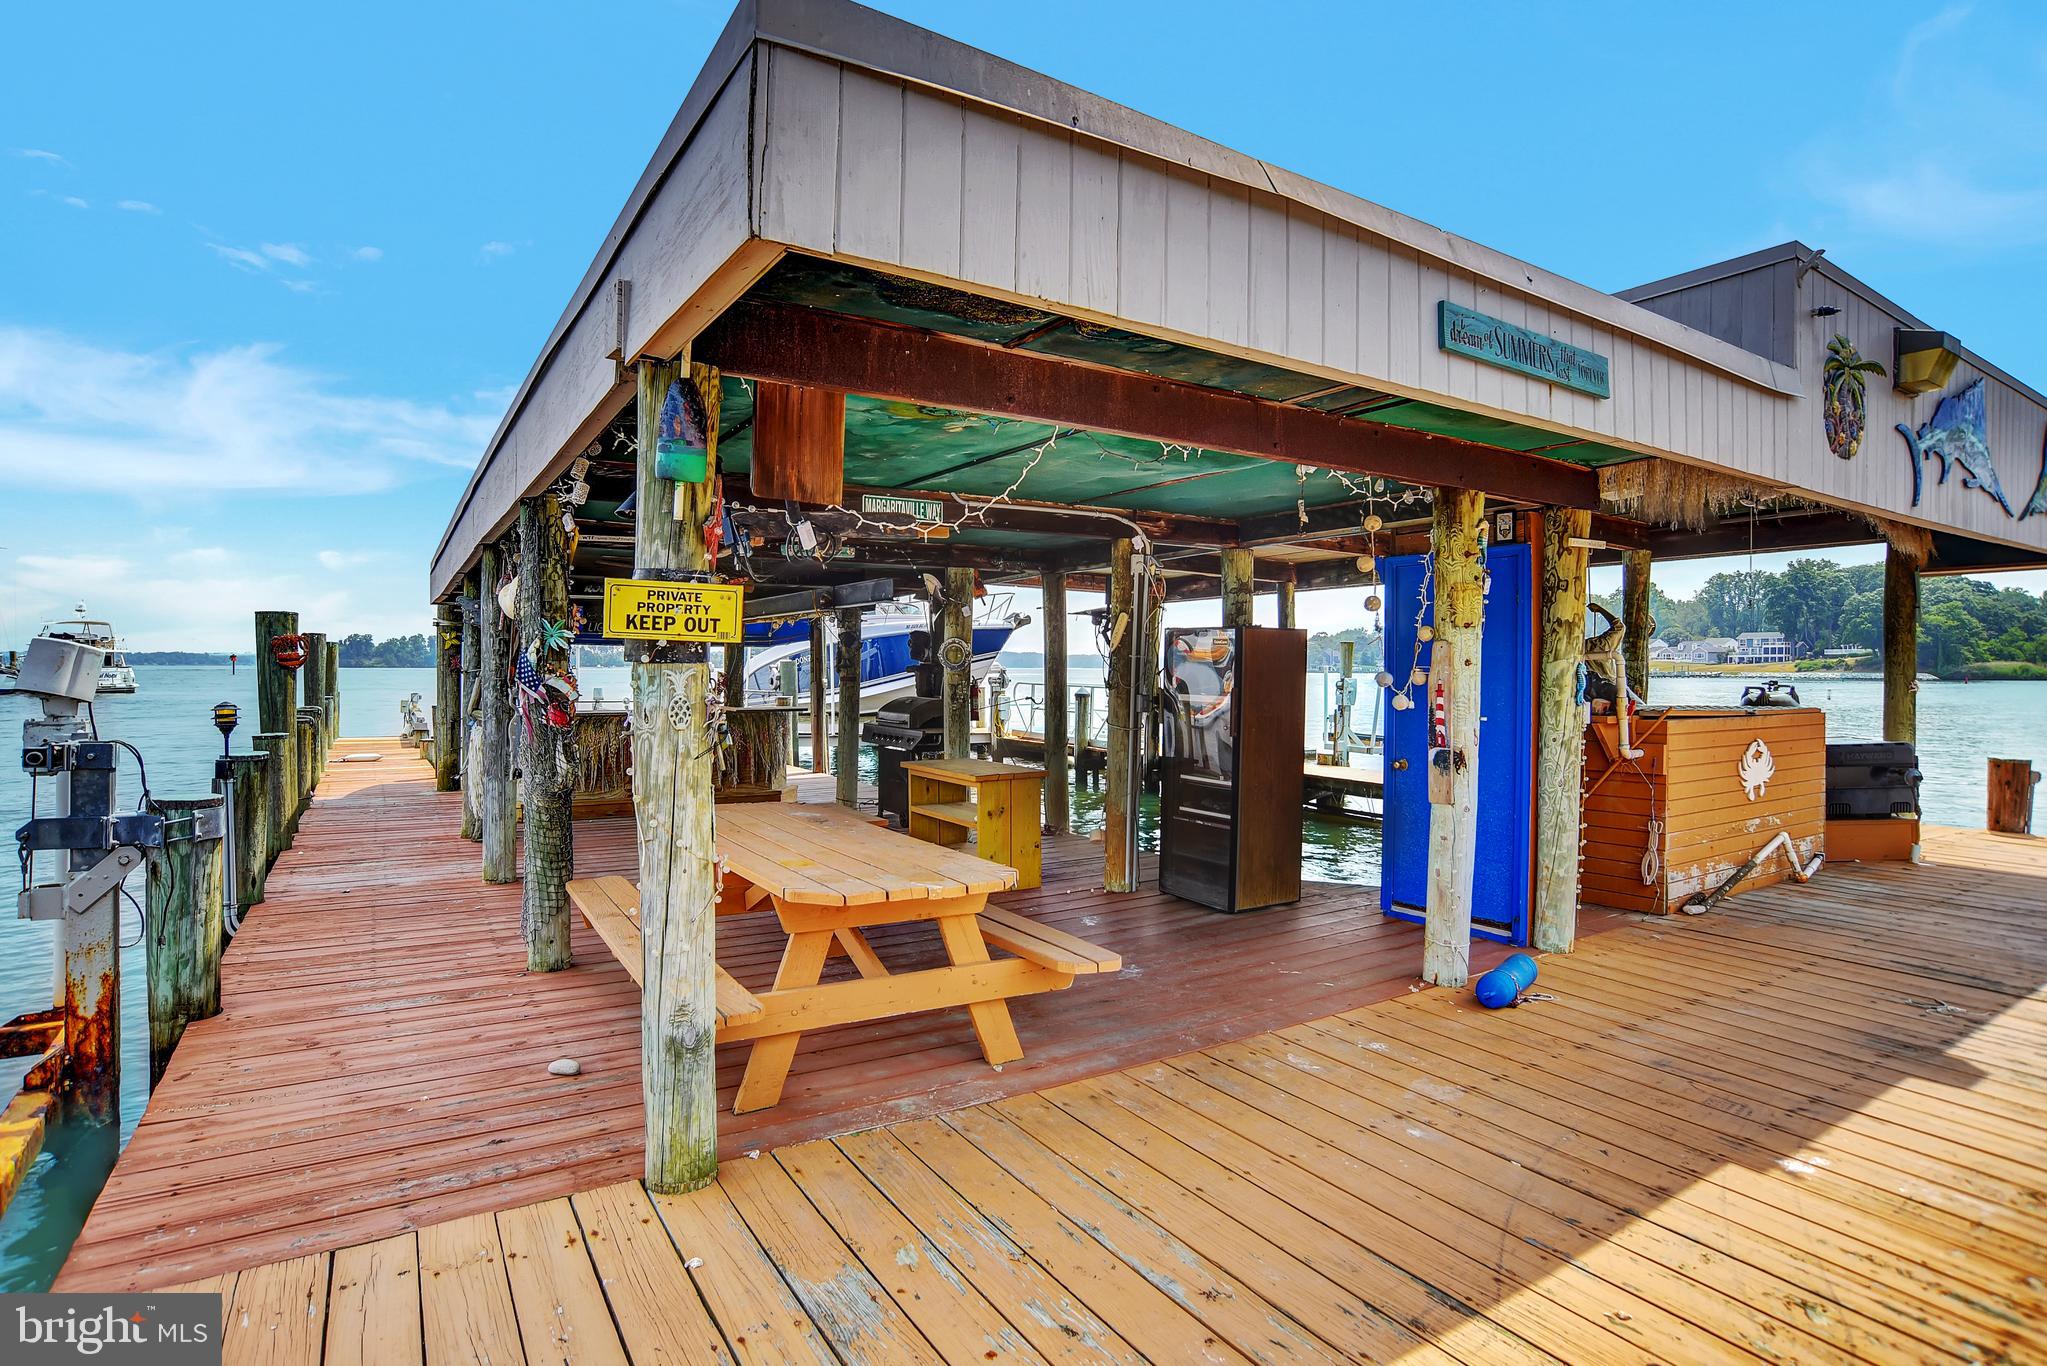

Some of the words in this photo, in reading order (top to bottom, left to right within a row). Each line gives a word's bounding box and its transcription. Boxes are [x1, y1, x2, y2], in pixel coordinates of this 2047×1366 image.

[1450, 320, 1483, 350] dream
[1484, 329, 1494, 349] of
[1494, 325, 1555, 373] SUMMERS
[1559, 346, 1577, 367] that
[1555, 359, 1571, 381] last
[865, 497, 925, 519] MARGARITAVILLE
[926, 503, 941, 520] WAY
[647, 589, 703, 603] PRIVATE
[637, 602, 711, 616] PROPERTY
[626, 614, 676, 632] KEEP
[684, 616, 721, 633] OUT
